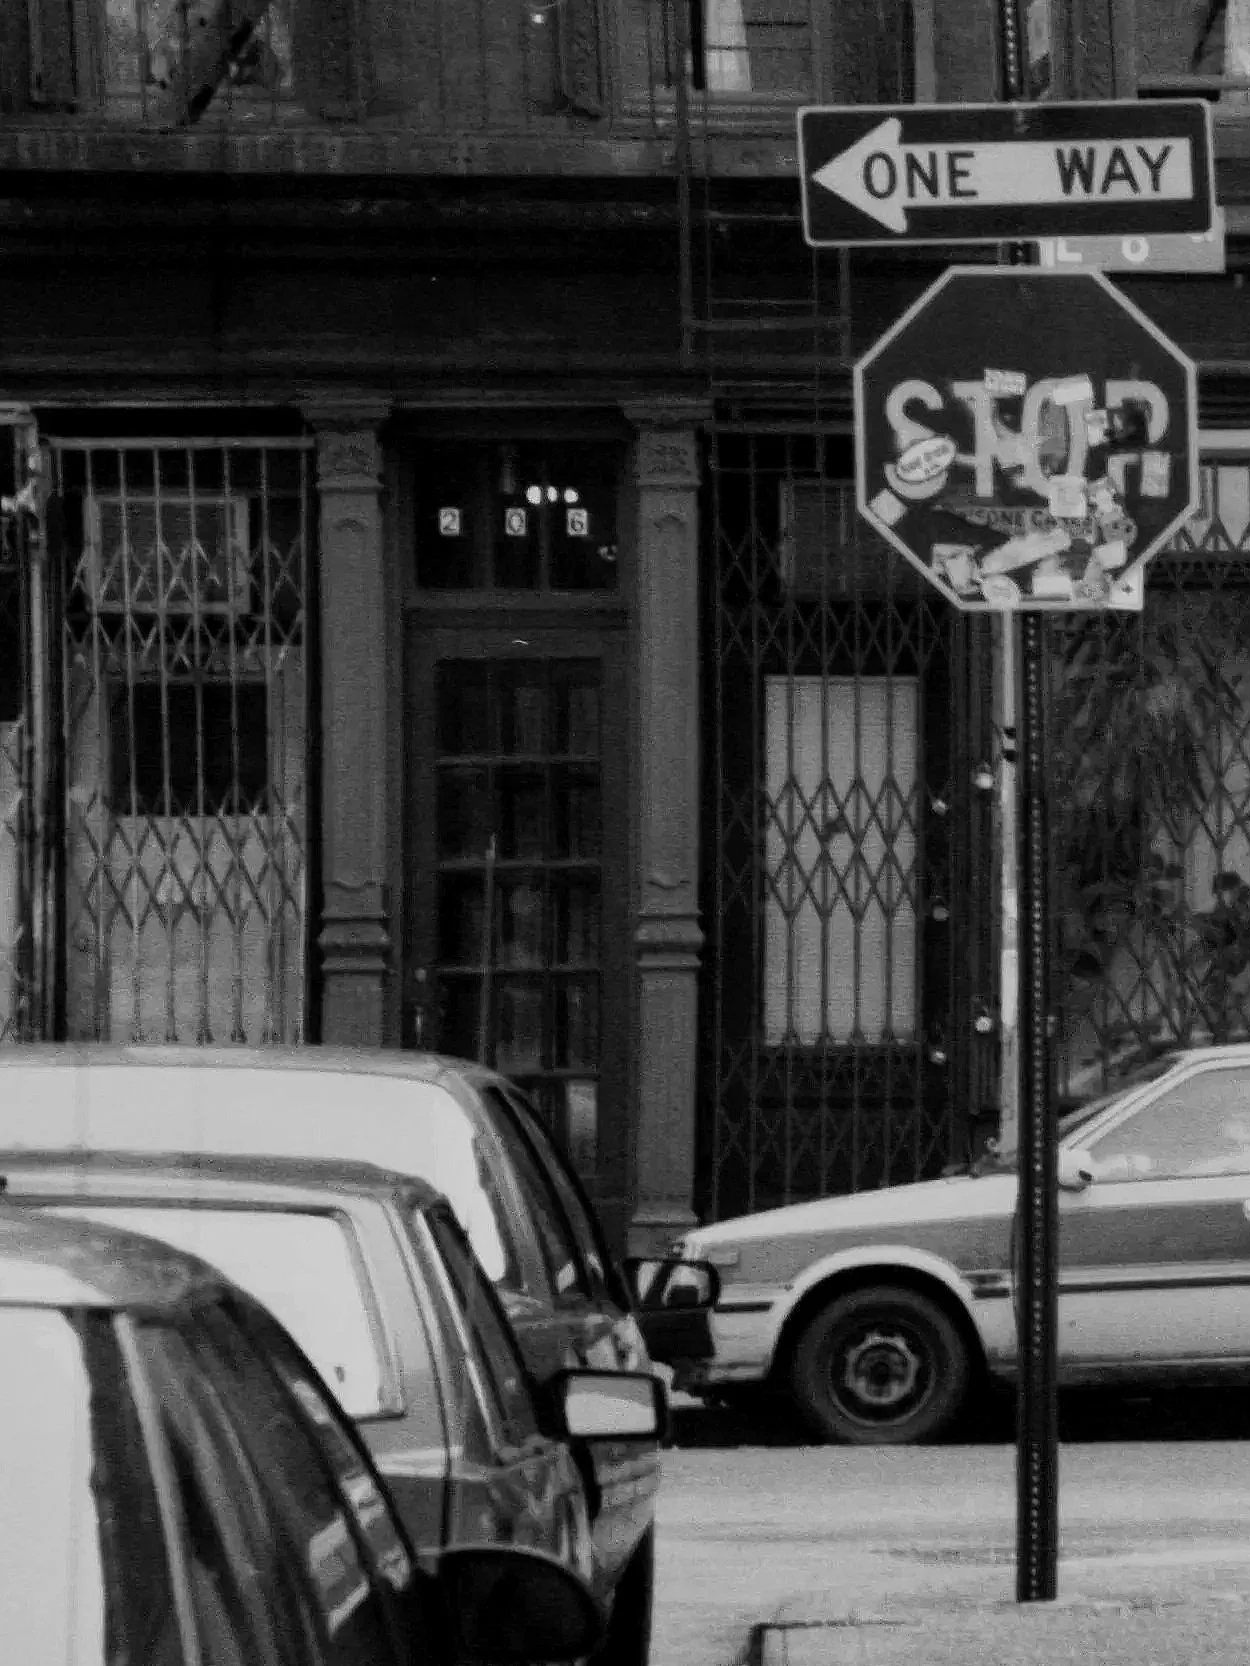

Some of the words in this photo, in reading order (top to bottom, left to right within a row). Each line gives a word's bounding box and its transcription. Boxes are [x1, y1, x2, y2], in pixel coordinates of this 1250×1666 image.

[862, 150, 979, 200] ONE
[1054, 144, 1174, 196] WAY
[885, 377, 1170, 500] STOP
